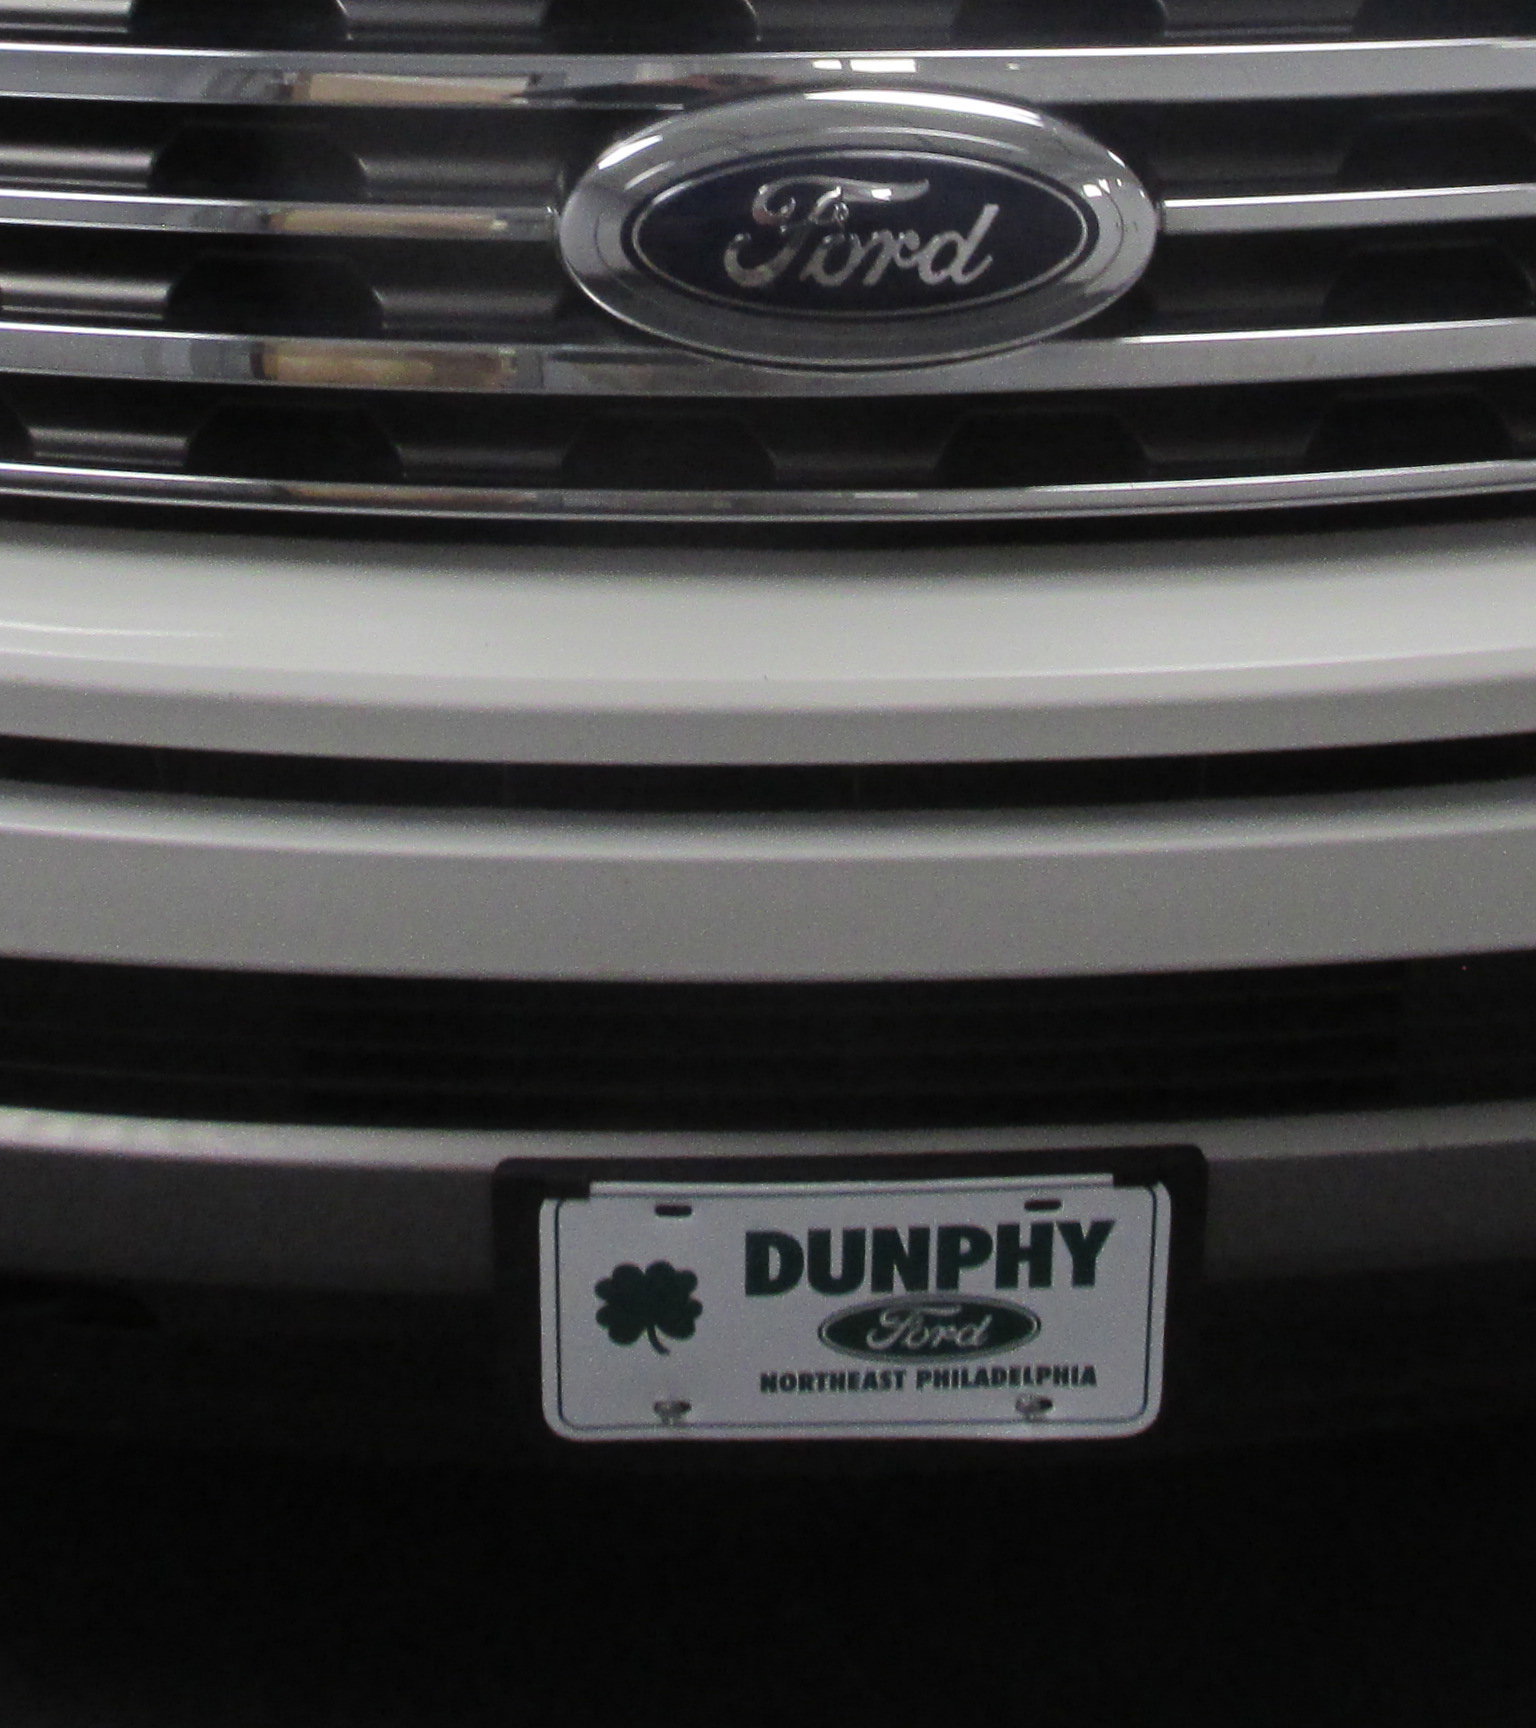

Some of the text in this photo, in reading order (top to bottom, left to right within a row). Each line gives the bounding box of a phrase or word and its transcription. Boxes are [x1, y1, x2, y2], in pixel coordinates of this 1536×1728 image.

[723, 175, 1000, 287] Ford
[744, 1218, 1117, 1297] DUNPHY
[867, 1305, 992, 1350] Ford
[760, 1366, 1098, 1394] NORTHEAST PHILADELPHIA
